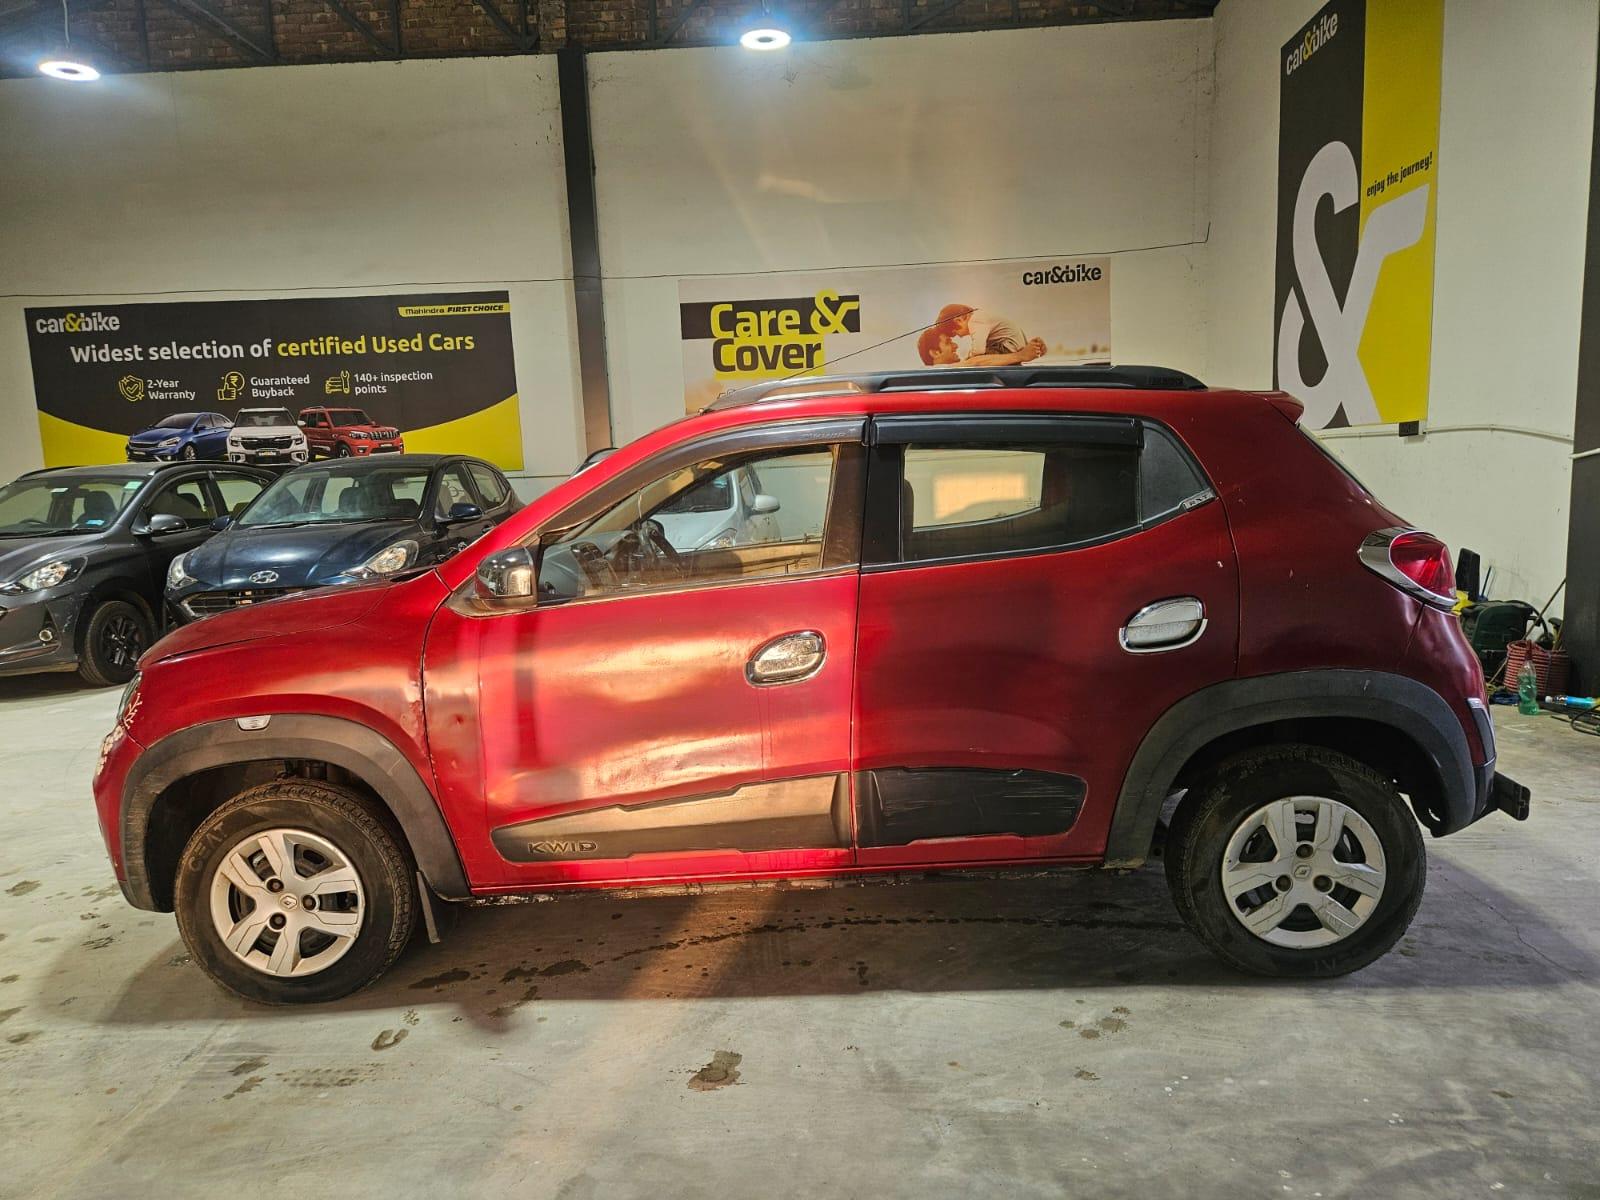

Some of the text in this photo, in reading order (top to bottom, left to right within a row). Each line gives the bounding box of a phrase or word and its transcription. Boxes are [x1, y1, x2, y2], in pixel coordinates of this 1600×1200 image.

[1286, 13, 1338, 75] car&bike
[1366, 151, 1433, 197] enjoy the journey!
[1022, 264, 1102, 286] car&bike
[472, 304, 504, 312] CHOICE
[710, 288, 859, 338] Care &
[36, 312, 120, 334] car&bike
[70, 333, 475, 363] Widest selection of certified Used Cars
[712, 338, 822, 373] Cover
[147, 379, 179, 389] 2-Year
[250, 374, 310, 386] Guaranteed
[354, 371, 433, 383] 140+ inspection
[148, 390, 196, 401] Warranty
[252, 386, 295, 398] Buyback
[355, 384, 387, 396] points
[527, 840, 598, 854] KWID
